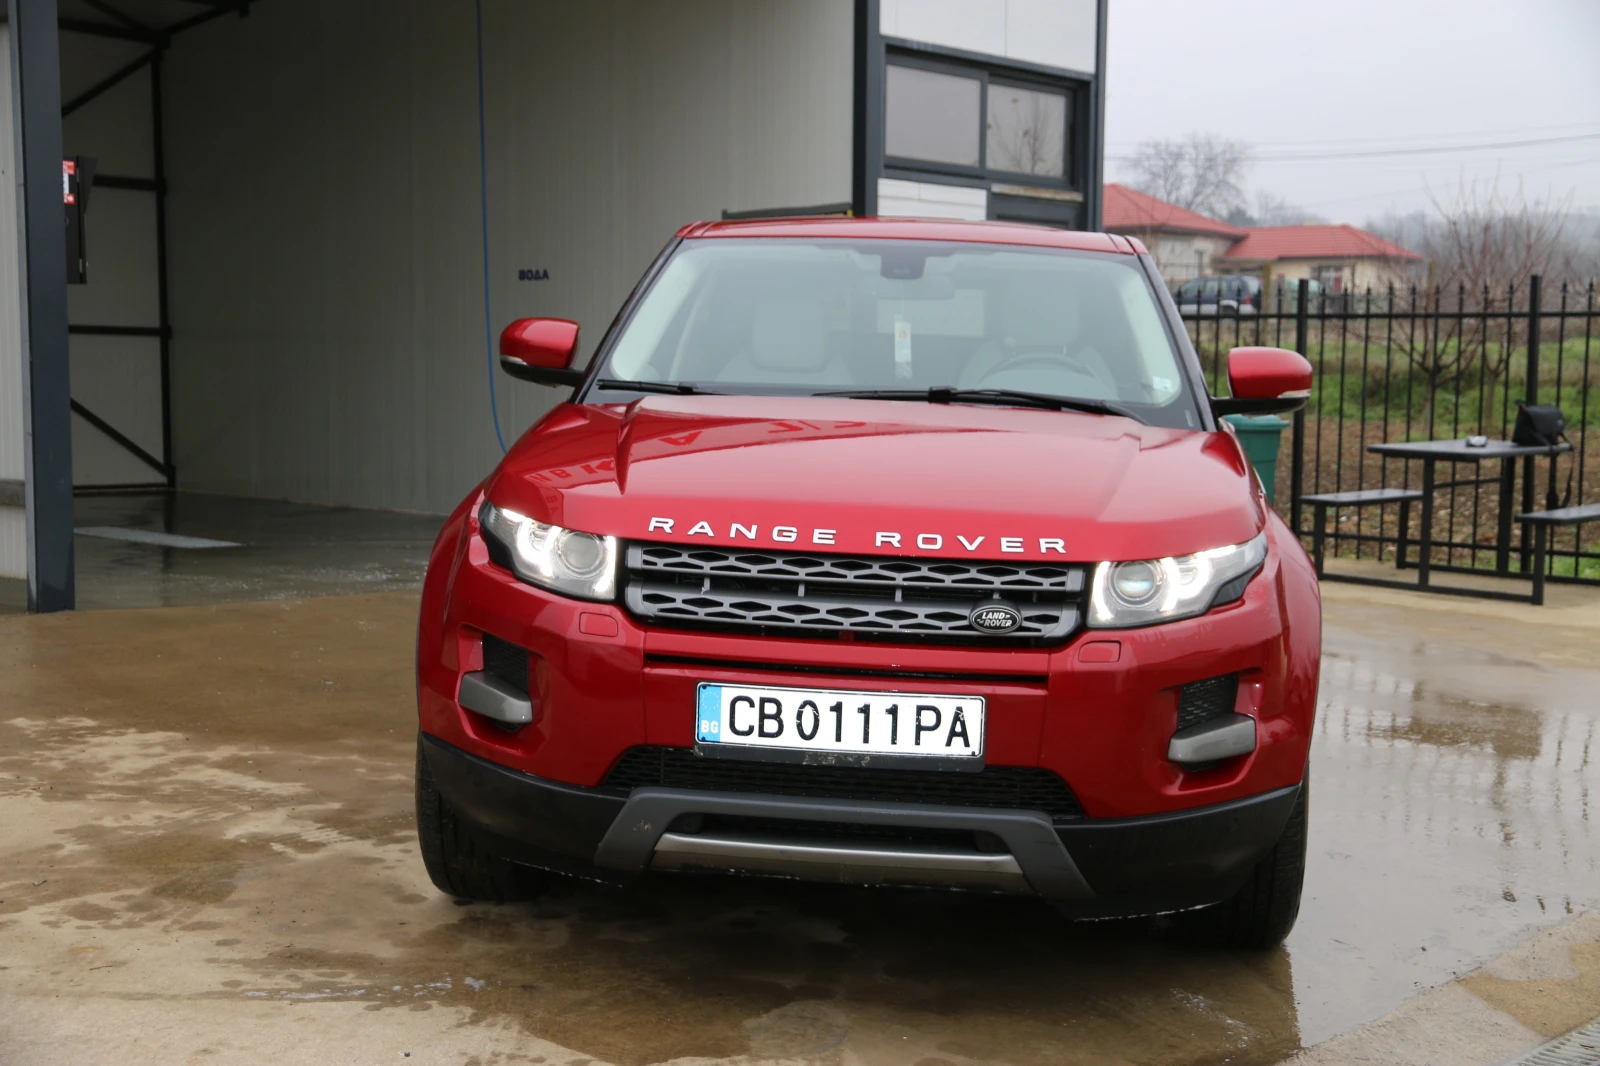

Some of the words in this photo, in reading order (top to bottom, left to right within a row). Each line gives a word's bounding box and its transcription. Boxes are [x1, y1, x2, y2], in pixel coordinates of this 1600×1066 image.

[648, 516, 837, 545] RANGE
[875, 531, 1067, 554] ROVER
[981, 611, 1006, 620] LAND
[983, 619, 1013, 627] ROVER
[701, 719, 719, 733] BG
